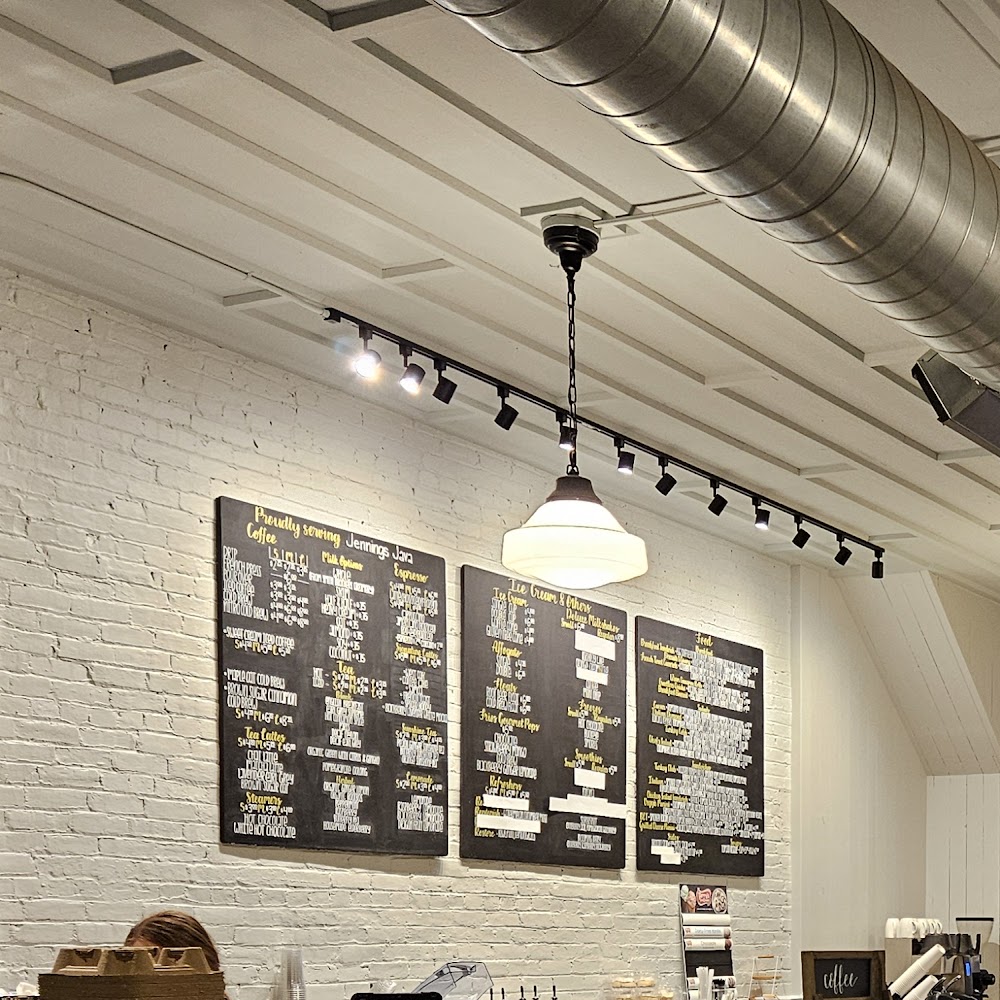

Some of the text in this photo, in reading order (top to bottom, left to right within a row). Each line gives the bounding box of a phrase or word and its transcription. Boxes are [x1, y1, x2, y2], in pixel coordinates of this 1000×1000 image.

[247, 522, 277, 544] Coffee
[255, 506, 413, 564] Proudly serving Jennings Java
[223, 545, 238, 560] DRIP
[394, 562, 428, 583] Espresso
[508, 578, 527, 594] Ice
[530, 583, 558, 604] Cream
[565, 595, 592, 614] Others
[336, 661, 355, 675] Tea
[257, 673, 269, 686] COLD
[244, 727, 260, 739] Tea
[823, 964, 858, 995] coffee
